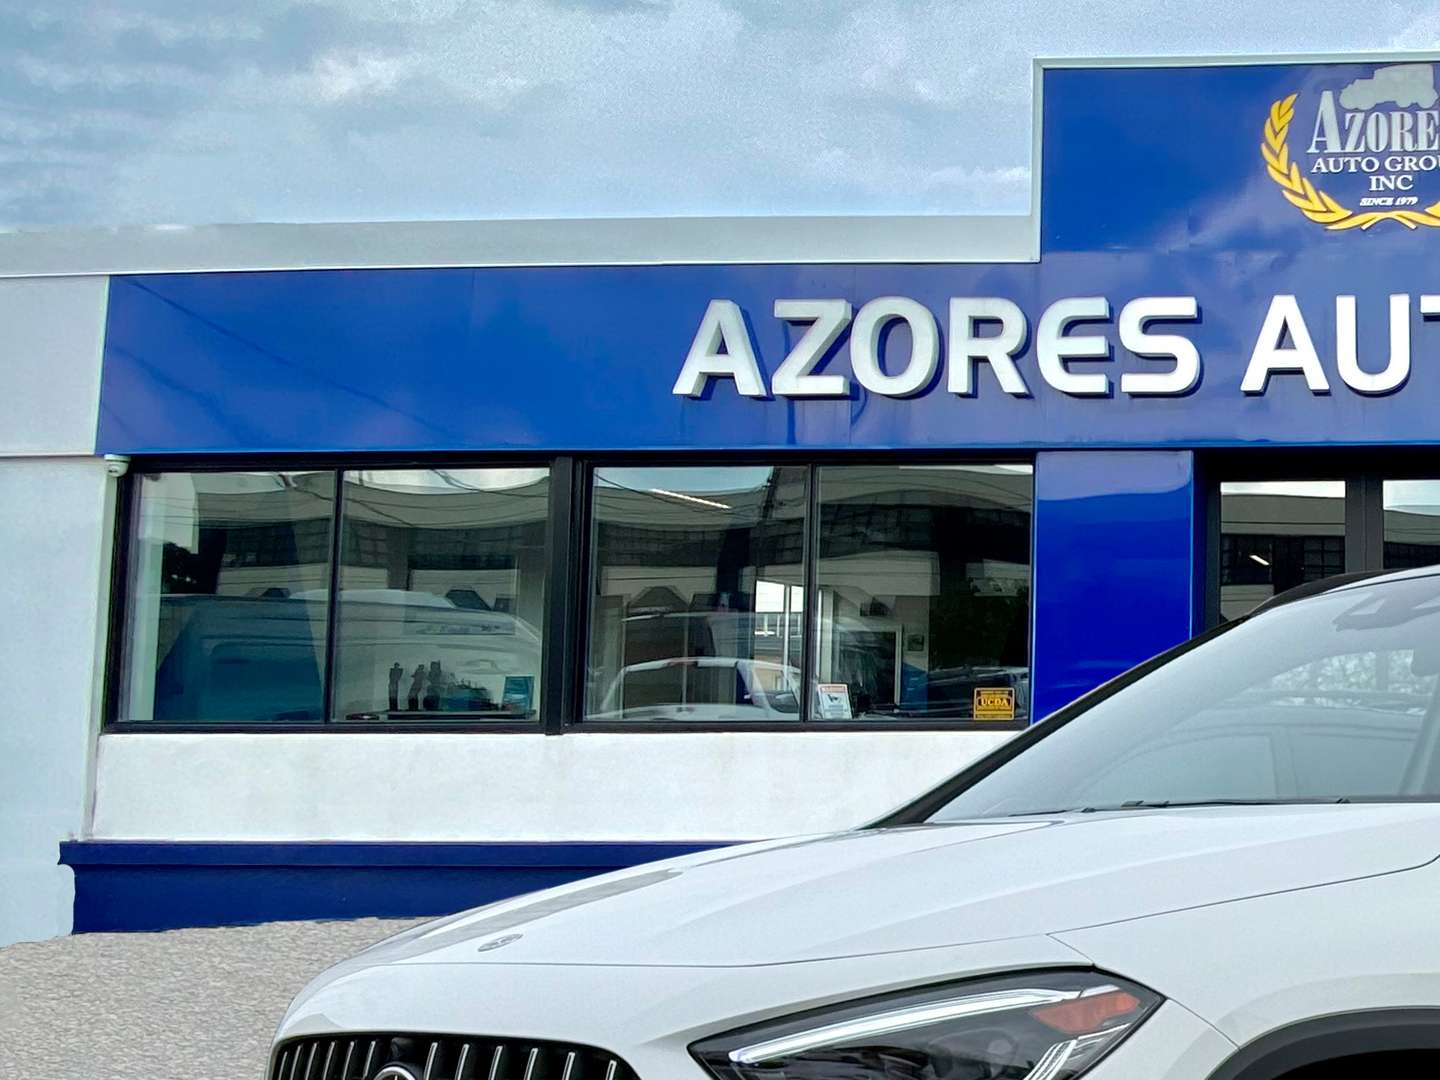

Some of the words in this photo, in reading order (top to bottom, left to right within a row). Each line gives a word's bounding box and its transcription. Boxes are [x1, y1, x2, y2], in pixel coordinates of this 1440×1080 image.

[1311, 156, 1380, 173] AUTO
[1368, 174, 1413, 191] INC
[1360, 197, 1394, 207] SINCE
[1395, 196, 1418, 206] 1979
[672, 296, 1202, 398] AZORES
[980, 698, 1010, 706] UCDA
